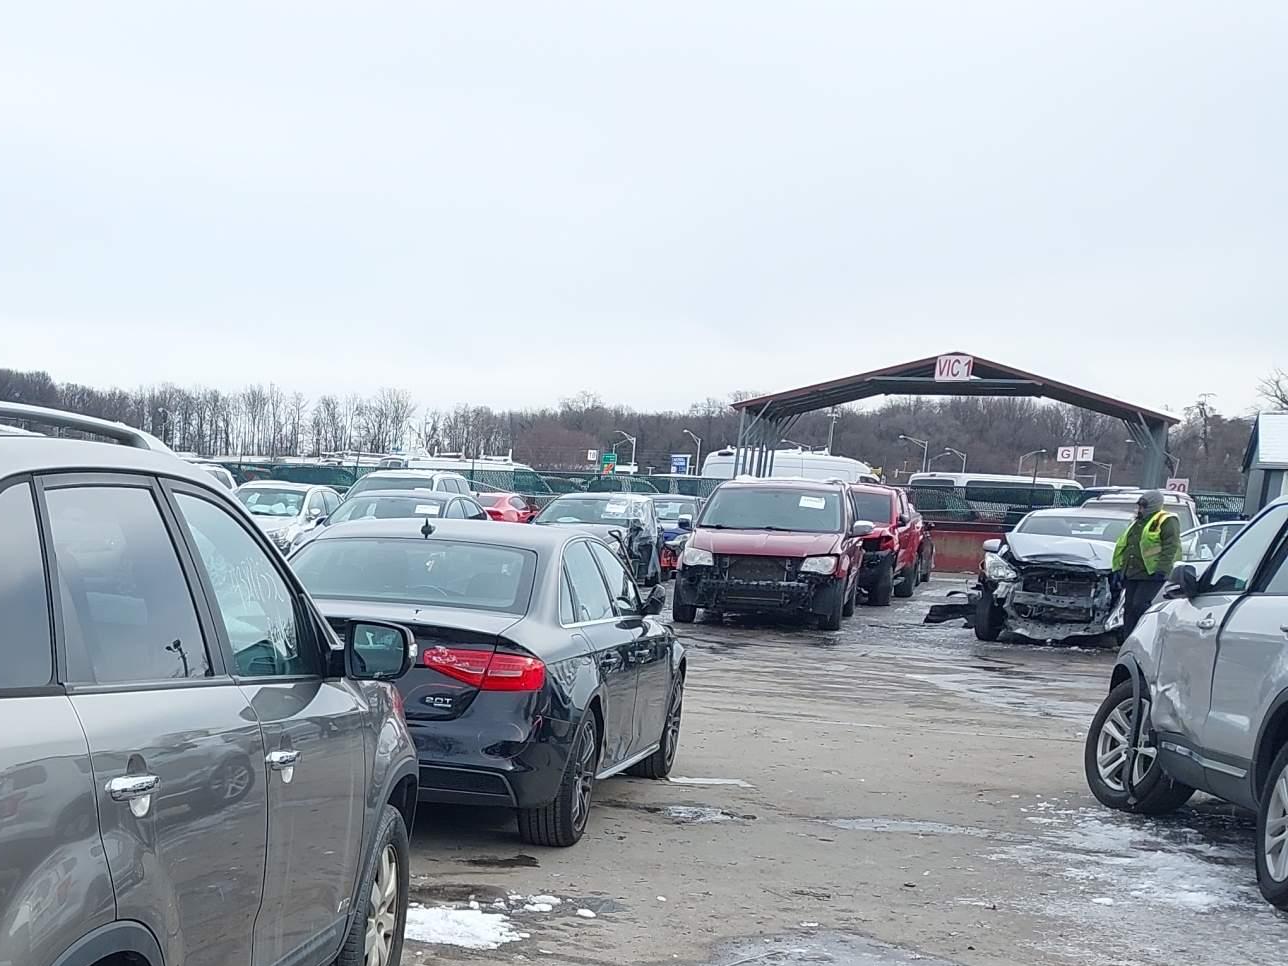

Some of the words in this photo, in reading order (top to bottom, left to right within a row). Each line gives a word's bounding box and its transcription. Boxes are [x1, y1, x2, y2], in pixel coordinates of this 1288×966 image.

[938, 358, 961, 377] VIC
[964, 359, 972, 377] 1
[1061, 449, 1071, 459] G
[1081, 448, 1090, 459] F
